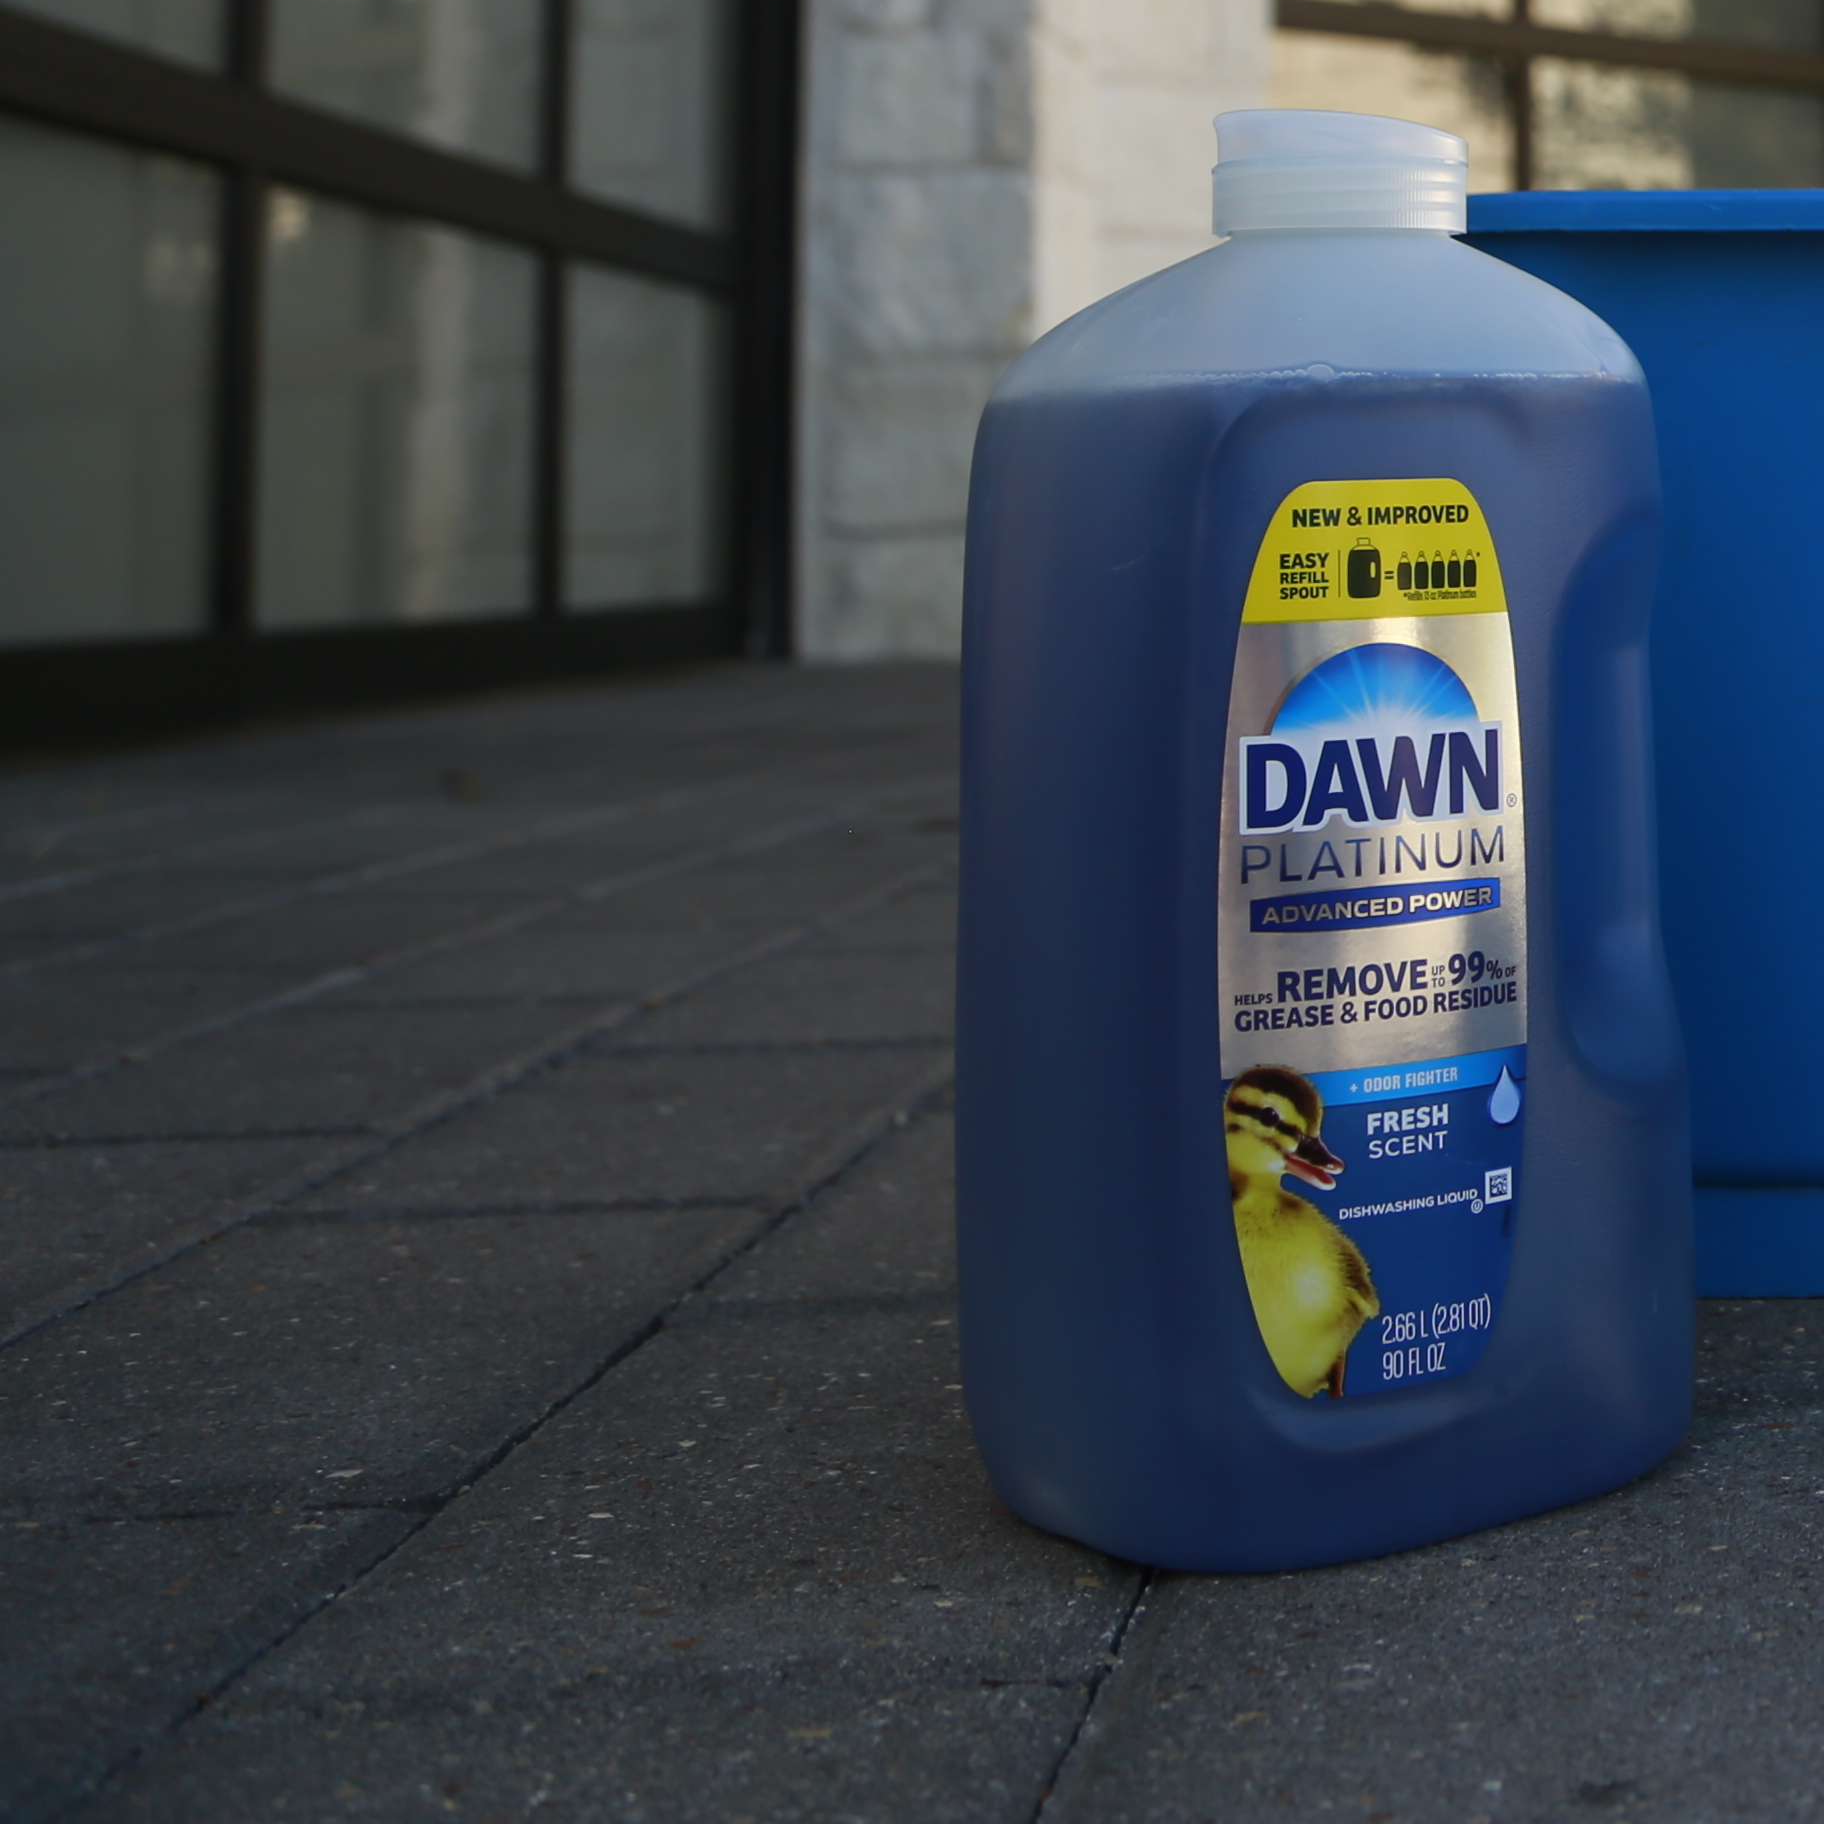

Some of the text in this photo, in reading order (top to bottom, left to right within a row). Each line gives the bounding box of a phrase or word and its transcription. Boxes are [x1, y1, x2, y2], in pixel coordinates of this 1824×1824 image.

[1292, 505, 1469, 527] NEW & IMPROVED
[1279, 553, 1329, 570] EASY
[1279, 586, 1329, 600] SPOUT
[1280, 571, 1329, 585] REFILL
[1246, 728, 1499, 829] DAWN
[1240, 825, 1505, 885] PLATINUM
[1262, 886, 1492, 925] ADVANCED POWER
[1234, 951, 1517, 1006] HELPS REMOVE UP TO 99% OF
[1234, 981, 1517, 1032] GREASE & FOOD RESIDUE
[1363, 1075, 1401, 1093] ODOR
[1405, 1067, 1458, 1088] FIGHTER
[1367, 1103, 1449, 1135] FRESH
[1368, 1131, 1448, 1159] SCENT
[1339, 1188, 1478, 1220] DISHWASHING LIQUID
[1382, 1293, 1491, 1344] 2.66 L (2.81 QT)
[1383, 1342, 1446, 1380] 90 FL OZ
